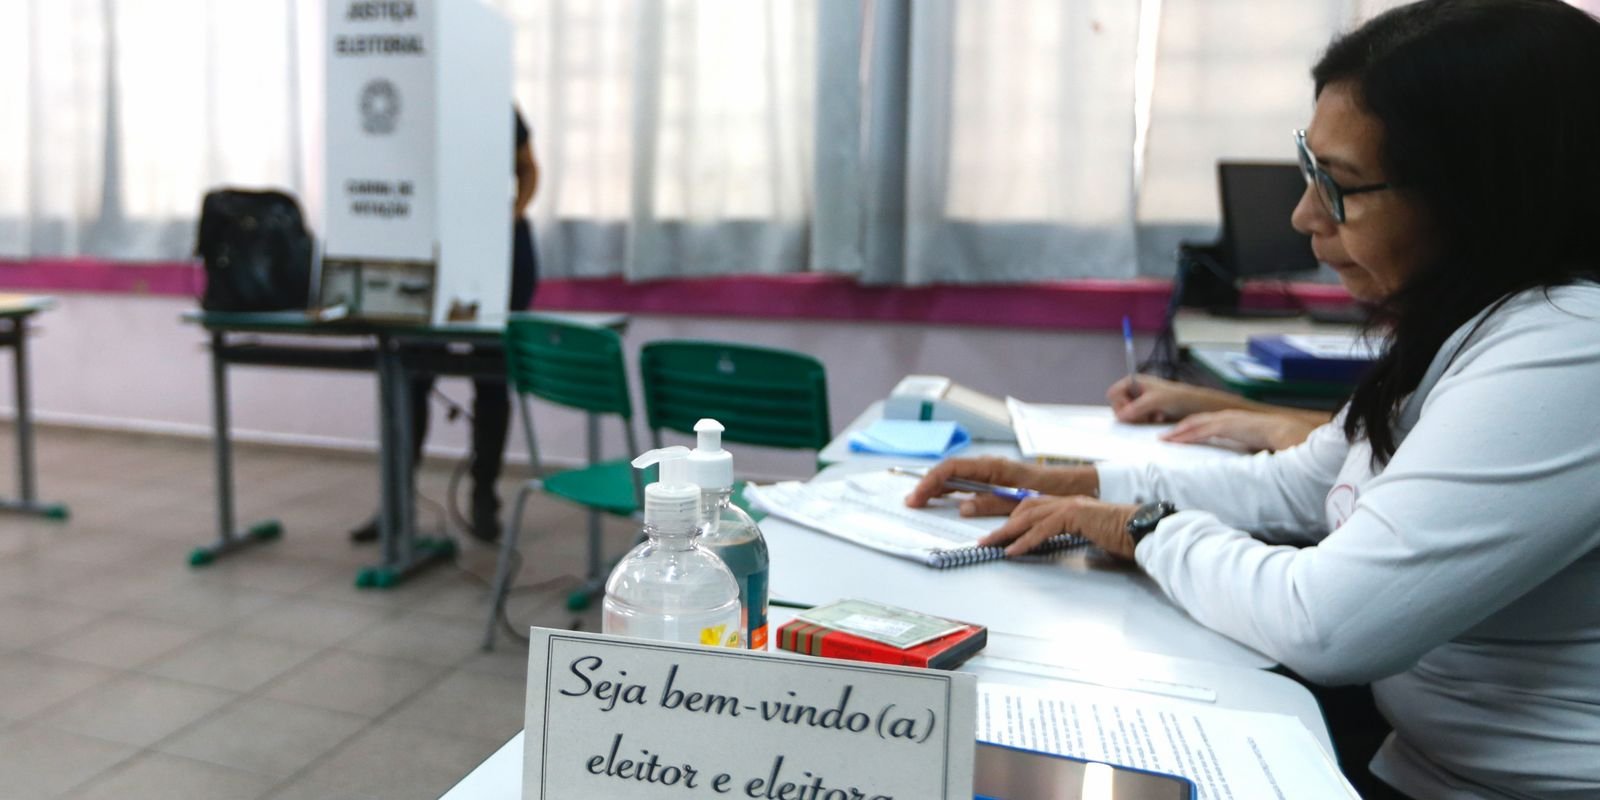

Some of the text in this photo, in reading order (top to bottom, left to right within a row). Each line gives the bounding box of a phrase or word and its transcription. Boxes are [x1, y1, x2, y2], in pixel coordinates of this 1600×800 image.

[335, 34, 425, 56] ELEITORAL
[559, 655, 936, 744] Seja bem-vindo(a)
[586, 733, 895, 800] eleitor e eleitor
